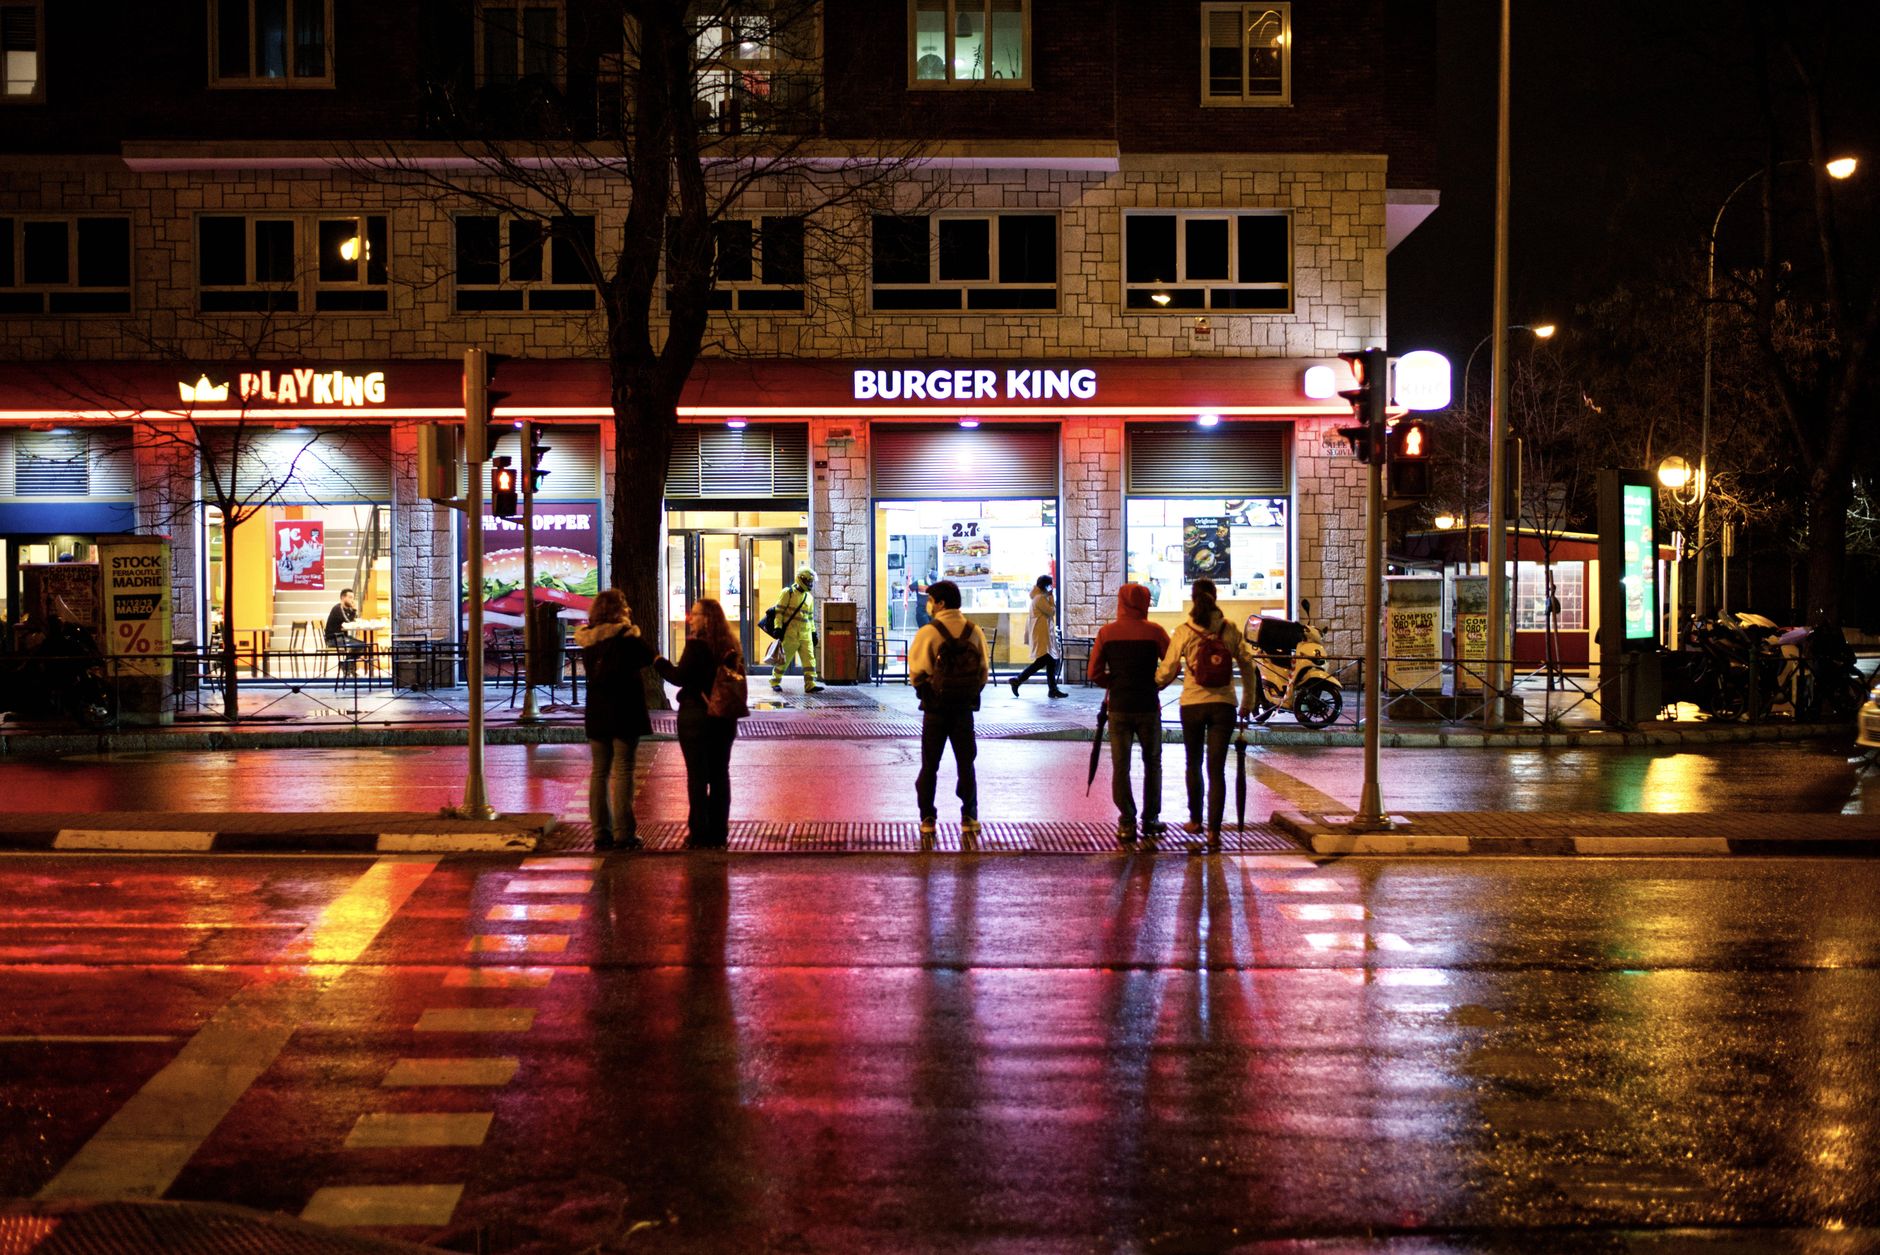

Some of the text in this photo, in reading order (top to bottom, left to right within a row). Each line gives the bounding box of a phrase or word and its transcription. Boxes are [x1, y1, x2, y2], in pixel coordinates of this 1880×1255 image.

[240, 368, 385, 406] PLAYKING
[854, 370, 1096, 399] BURGER KING
[112, 556, 161, 569] STOCK
[116, 606, 153, 614] MARZO
[1394, 613, 1433, 621] COMPRO
